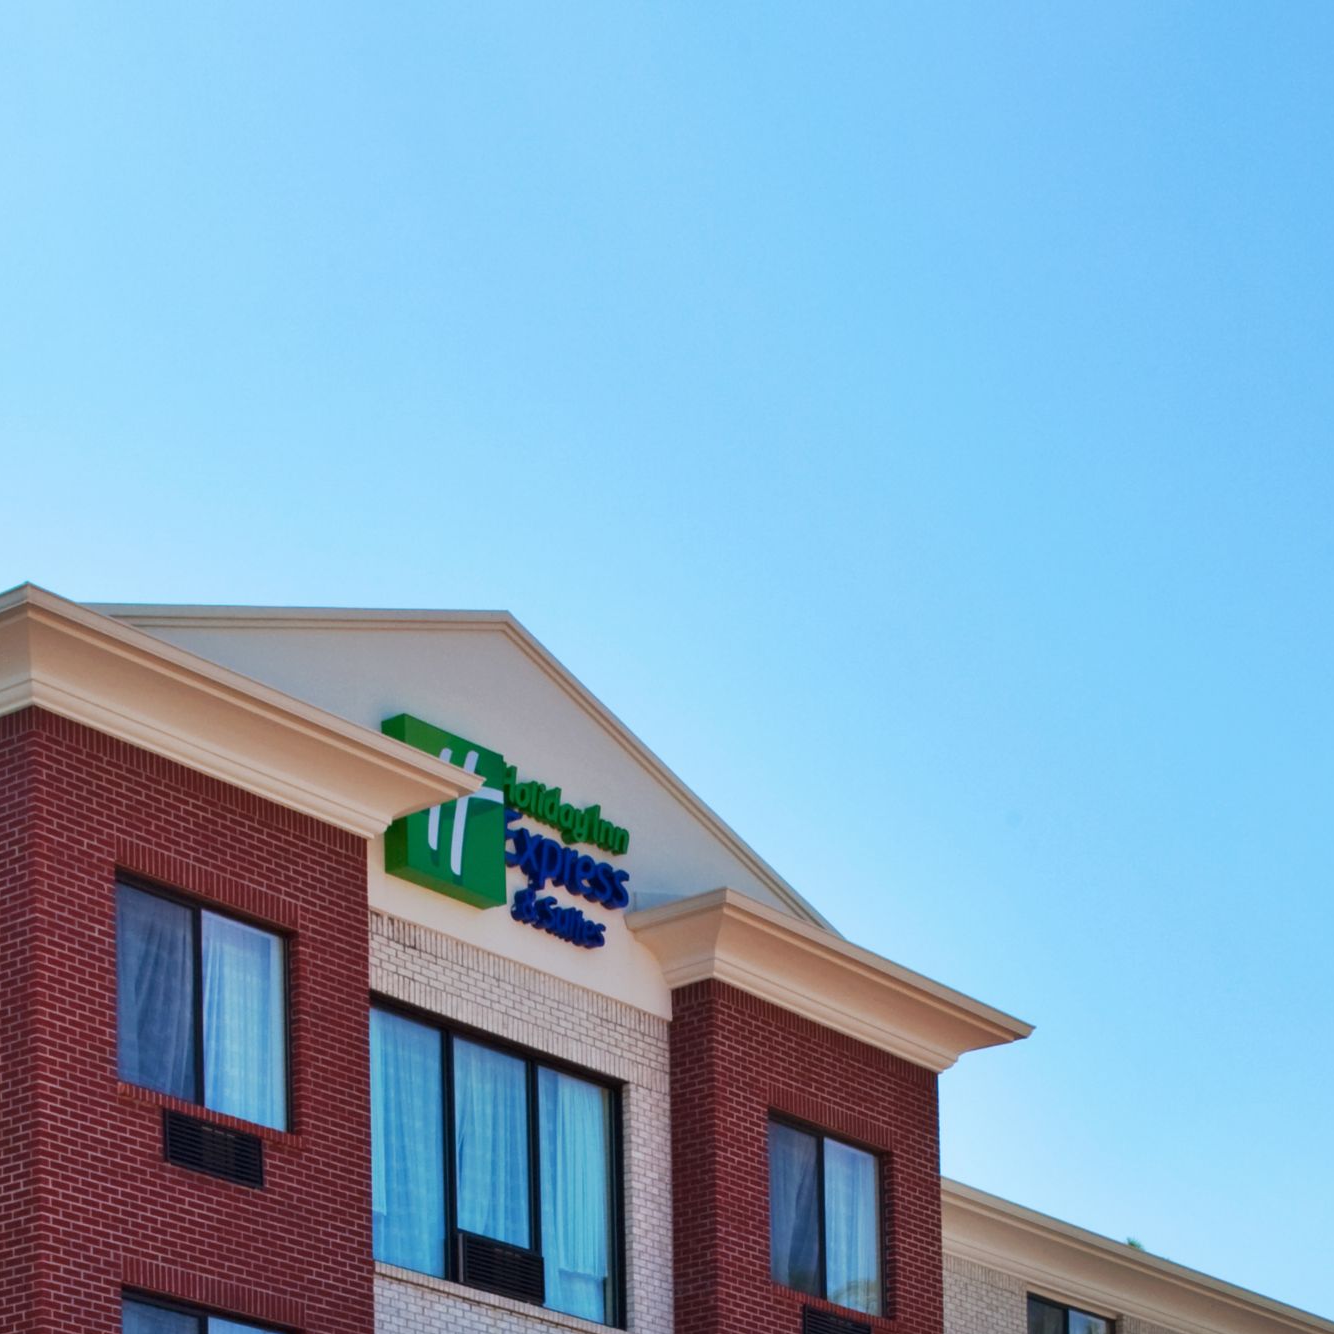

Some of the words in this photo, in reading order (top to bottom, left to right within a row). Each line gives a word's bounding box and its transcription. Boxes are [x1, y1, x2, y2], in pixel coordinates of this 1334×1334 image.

[504, 765, 587, 845] Holiday
[583, 804, 630, 856] Inn
[505, 809, 630, 910] Express
